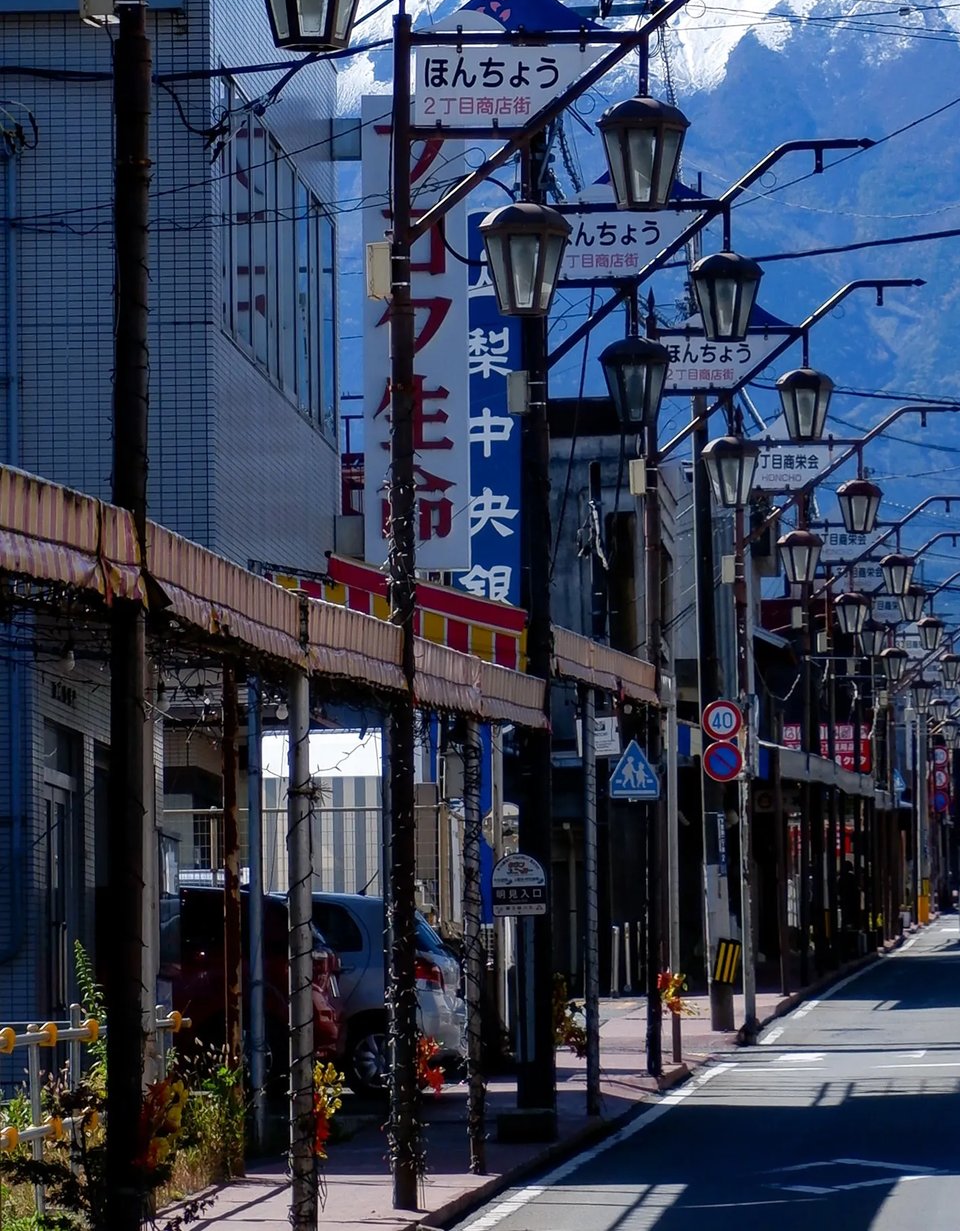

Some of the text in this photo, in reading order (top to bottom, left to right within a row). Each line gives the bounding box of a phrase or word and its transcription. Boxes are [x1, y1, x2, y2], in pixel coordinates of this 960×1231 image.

[425, 57, 559, 89] ほんちょう
[424, 96, 531, 115] 2丁目商店街
[566, 220, 660, 247] んちょう
[564, 253, 639, 268] 丁目商店街
[756, 454, 819, 469] 丁目商栄会
[816, 533, 867, 546] 丁目商栄会
[712, 711, 733, 729] 40
